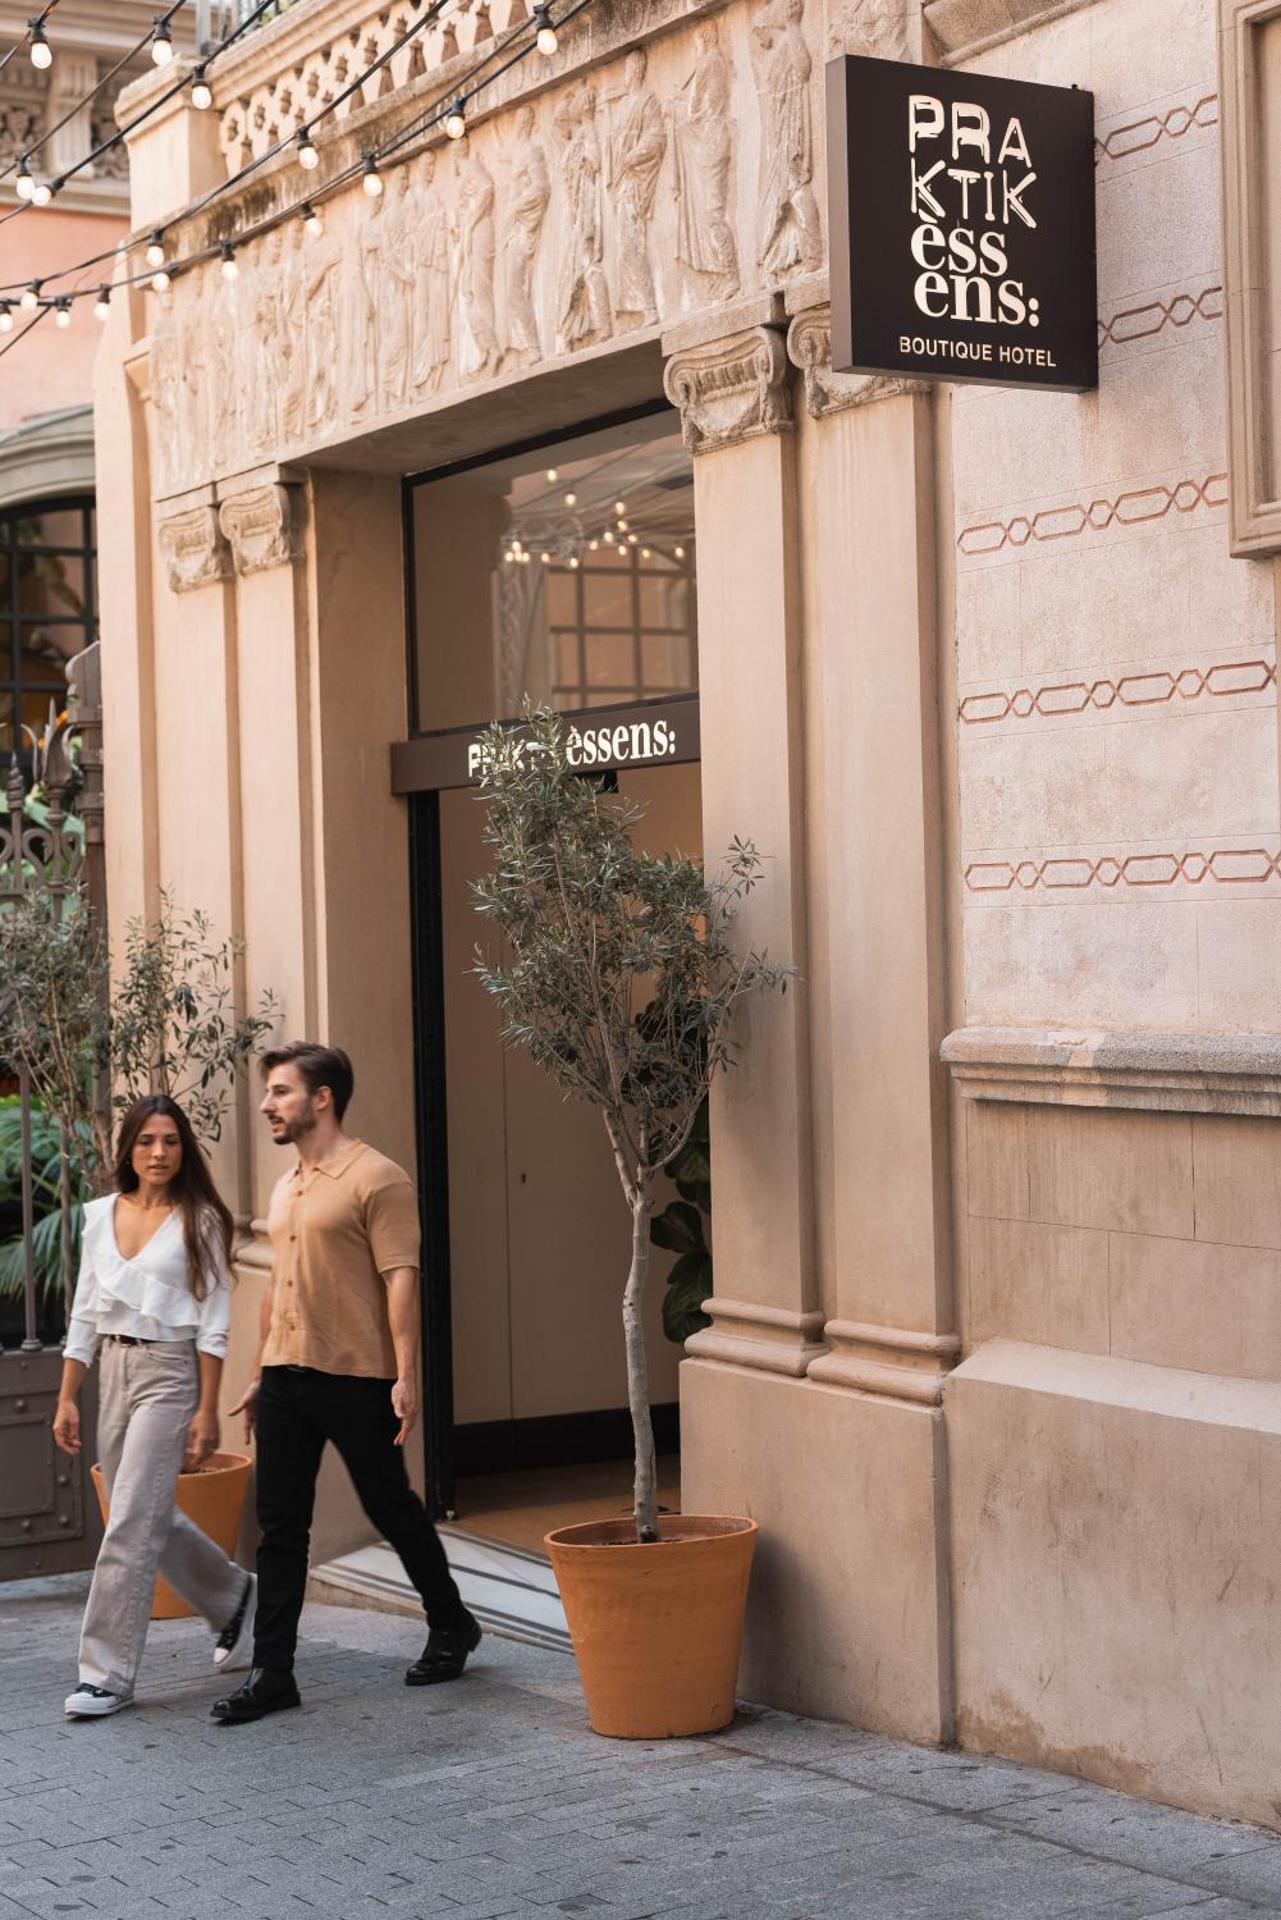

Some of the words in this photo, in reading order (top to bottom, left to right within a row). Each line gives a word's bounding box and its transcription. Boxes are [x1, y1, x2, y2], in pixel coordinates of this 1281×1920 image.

[908, 94, 1032, 169] PRA
[909, 157, 1038, 229] KTIK
[913, 271, 1040, 327] ens:
[900, 336, 993, 361] BOUTIQUE
[999, 345, 1057, 367] HOTEL
